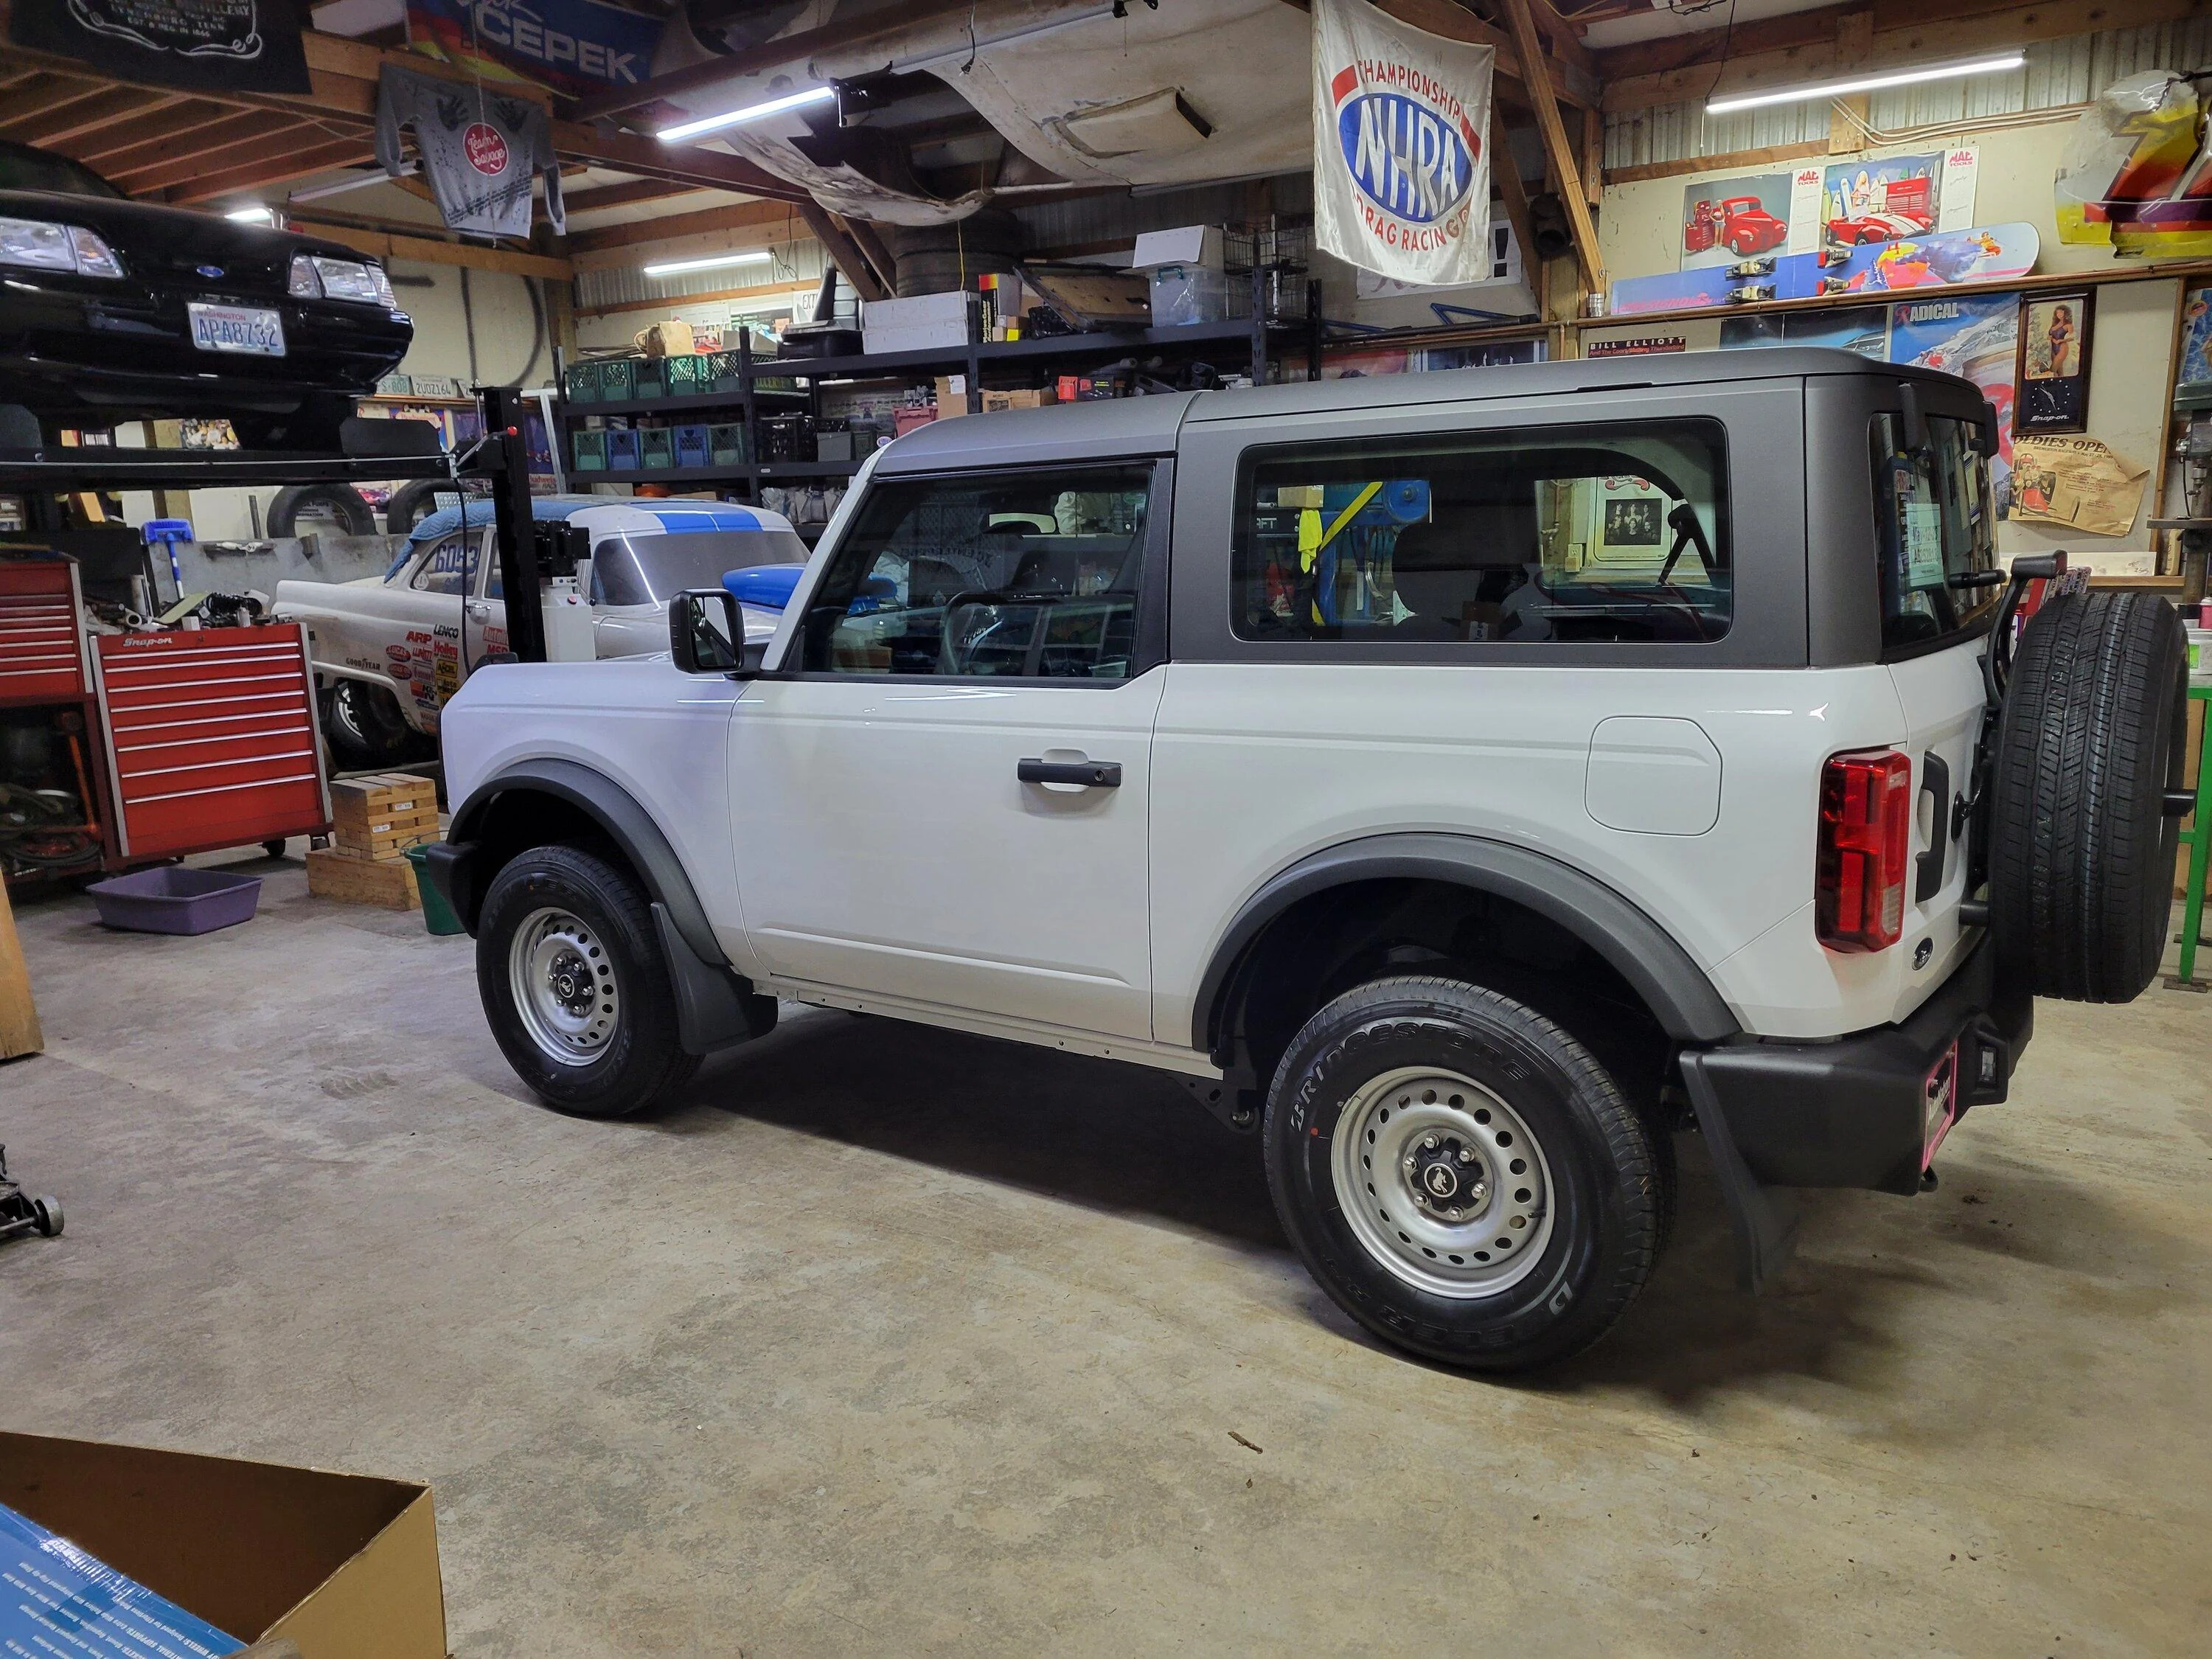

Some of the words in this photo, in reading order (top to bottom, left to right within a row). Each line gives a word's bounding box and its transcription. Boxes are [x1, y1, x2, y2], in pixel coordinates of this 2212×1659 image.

[477, 3, 639, 84] CEPEK
[467, 132, 498, 150] Team
[473, 147, 507, 170] Savage
[1354, 97, 1459, 218] NHRA
[1949, 150, 1973, 162] MAC
[1797, 170, 1819, 181] MAC
[1401, 218, 1459, 251] RACING
[197, 310, 246, 321] WASHINGTON
[1895, 302, 1960, 325] RADICAL
[198, 318, 279, 347] APA8732
[1626, 337, 1684, 347] ELLIOTT
[2030, 414, 2068, 422] Snap-on
[406, 630, 432, 644] ARP
[433, 624, 459, 639] LENCO
[122, 637, 173, 648] Snap-on
[434, 641, 459, 658] Holley
